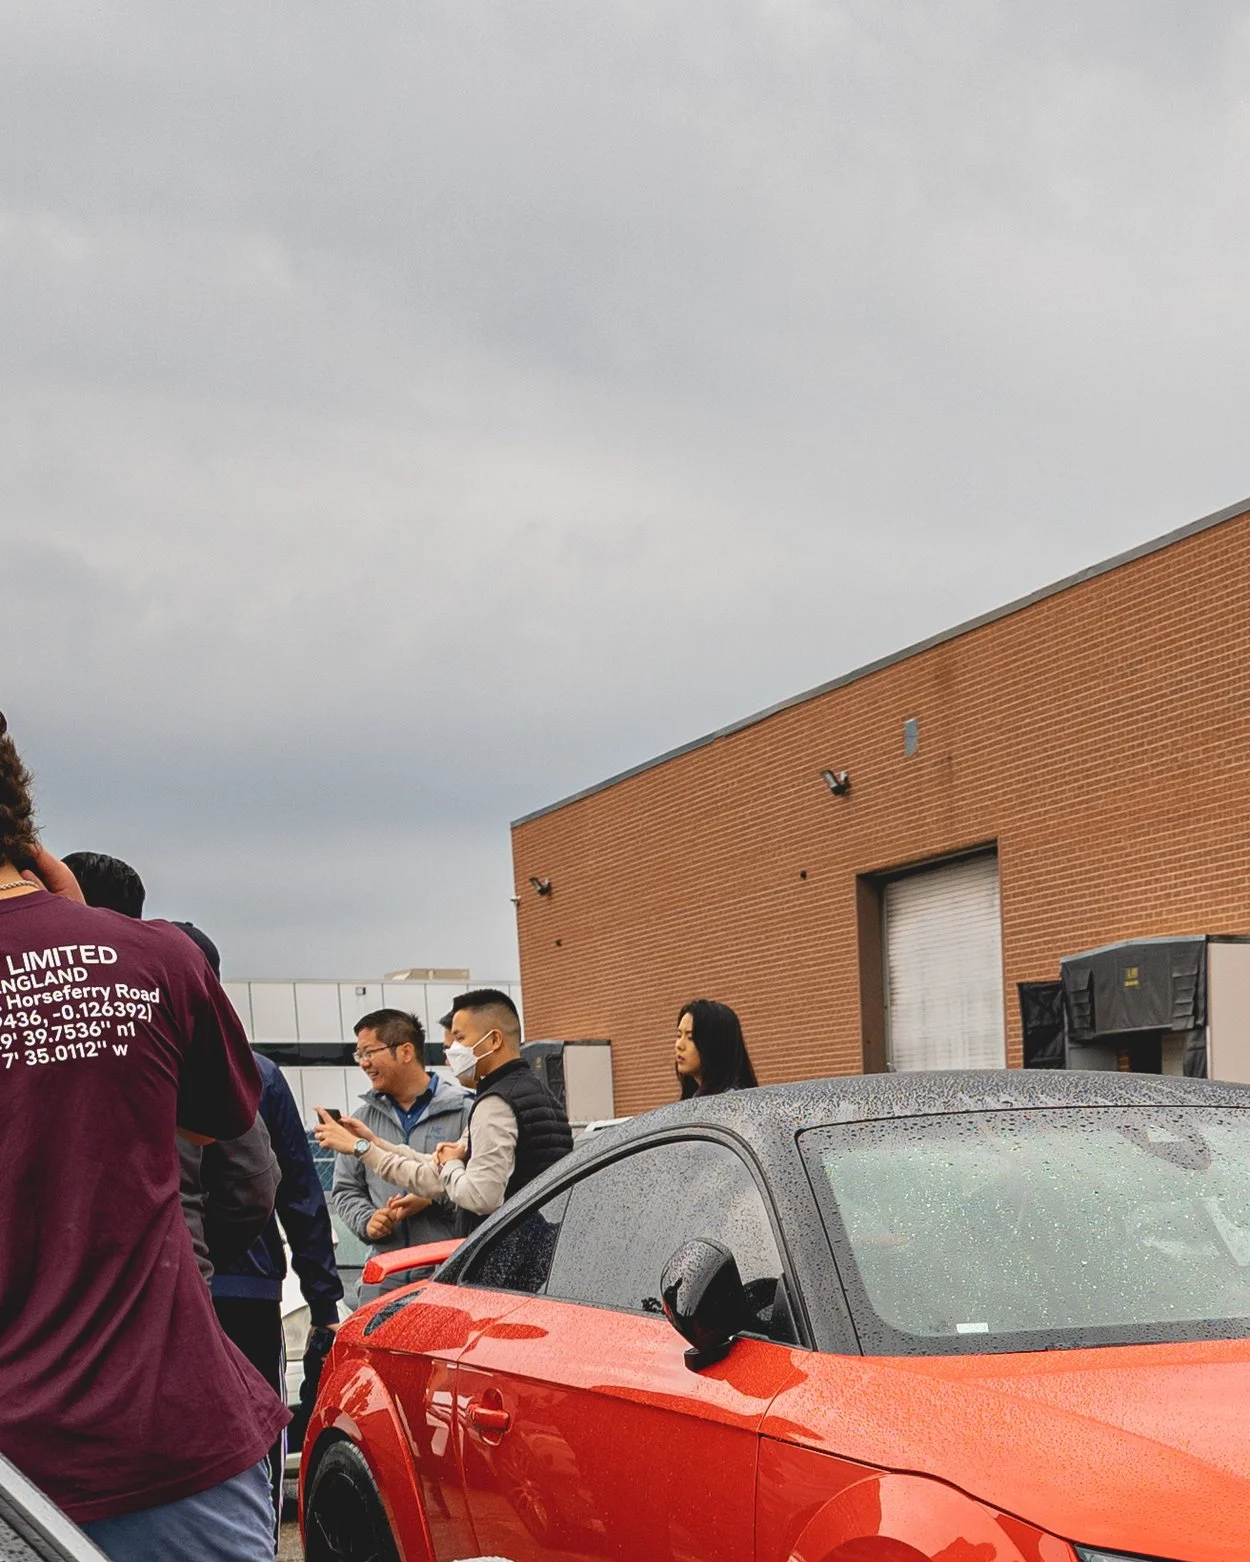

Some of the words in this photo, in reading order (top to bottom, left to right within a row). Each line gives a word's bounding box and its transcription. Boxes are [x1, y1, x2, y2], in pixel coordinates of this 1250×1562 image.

[6, 944, 118, 976] LIMITED
[0, 967, 88, 995] NGLAND
[6, 985, 110, 1010] Horseferry
[115, 983, 160, 1004] Road
[0, 1010, 48, 1028] 436,
[52, 1002, 152, 1023] -0.126392)
[0, 1032, 17, 1050] 9'
[112, 1043, 128, 1057] w
